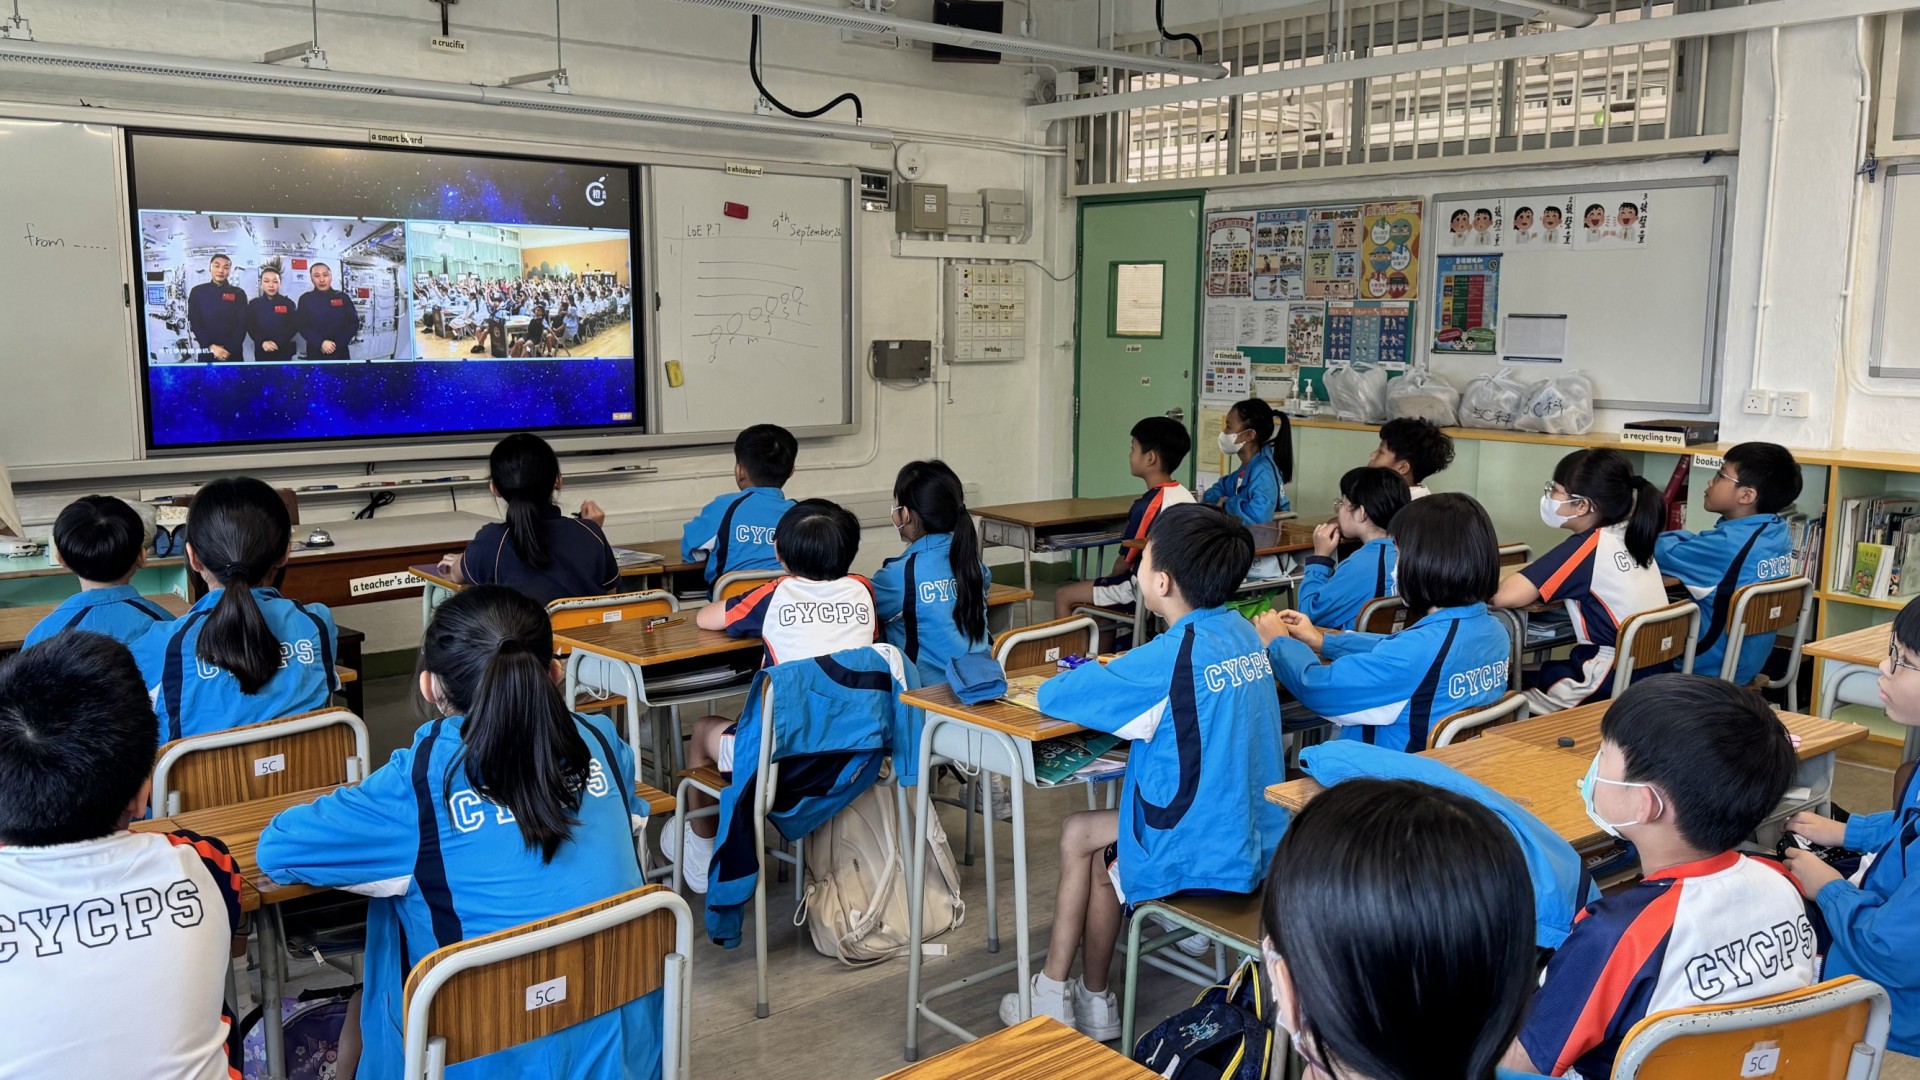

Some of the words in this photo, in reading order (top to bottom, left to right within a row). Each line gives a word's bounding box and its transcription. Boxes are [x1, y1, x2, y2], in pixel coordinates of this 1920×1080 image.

[438, 39, 465, 49] crucifix
[378, 134, 400, 143] smart
[731, 165, 762, 175] whiteboard
[24, 222, 65, 247] from
[1219, 351, 1242, 360] timetable
[1630, 432, 1663, 442] recycling
[1665, 435, 1682, 444] tray
[353, 584, 359, 592] a
[361, 575, 402, 591] teacher's
[779, 602, 870, 627] CYCPS
[196, 639, 315, 679] CPS
[1204, 649, 1273, 693] CYCPS
[262, 760, 277, 774] 5C
[1685, 913, 1814, 1001] CYCPS
[535, 986, 556, 1007] 5C
[1749, 1054, 1769, 1072] 5C
